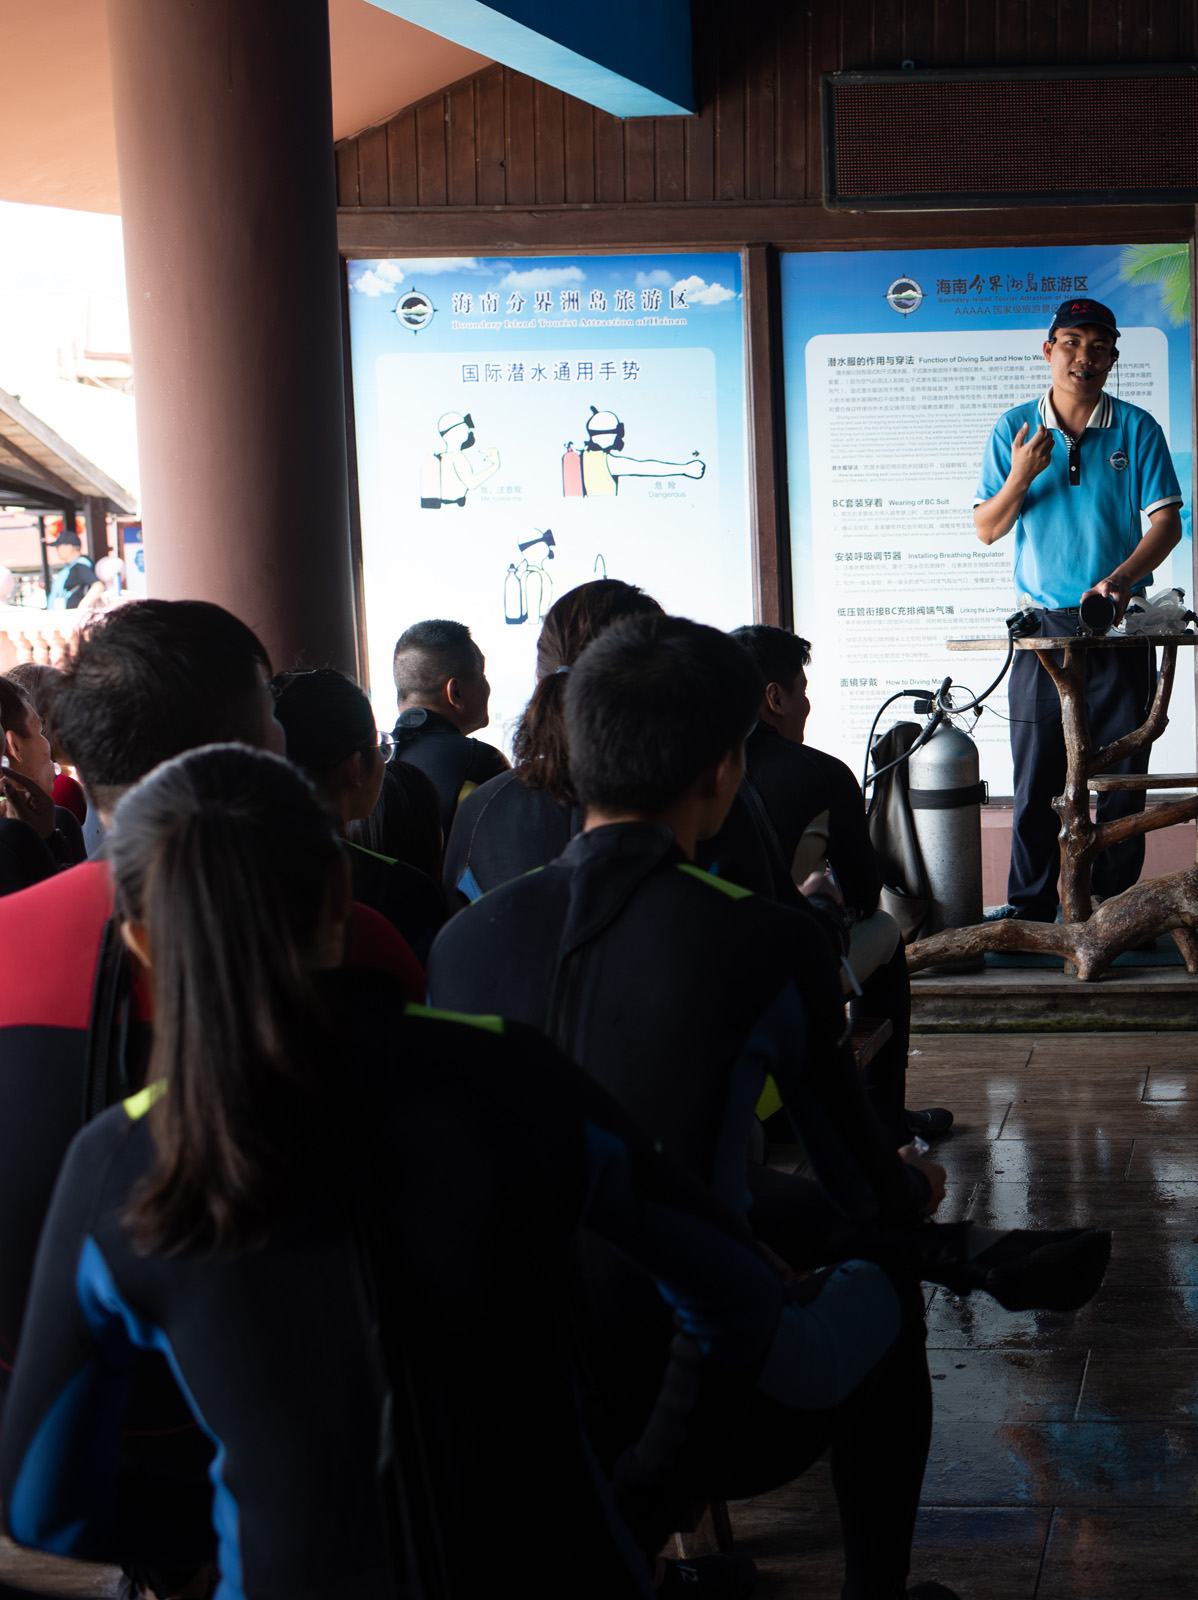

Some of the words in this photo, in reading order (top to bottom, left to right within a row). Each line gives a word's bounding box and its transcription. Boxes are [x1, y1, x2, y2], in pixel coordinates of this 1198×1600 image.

[452, 290, 690, 315] 海南分界洲岛旅游区
[955, 306, 991, 316] AAAAA
[451, 320, 502, 331] Boundary
[504, 319, 537, 329] Island
[538, 318, 577, 328] Tourist
[579, 318, 633, 327] Attraction
[648, 316, 687, 326] Hainan
[828, 355, 914, 367] 潜水服的作用与穿法
[462, 360, 641, 384] 国际潜水通用手势
[835, 552, 902, 561] 安装呼吸调节器
[908, 552, 938, 560] Installing
